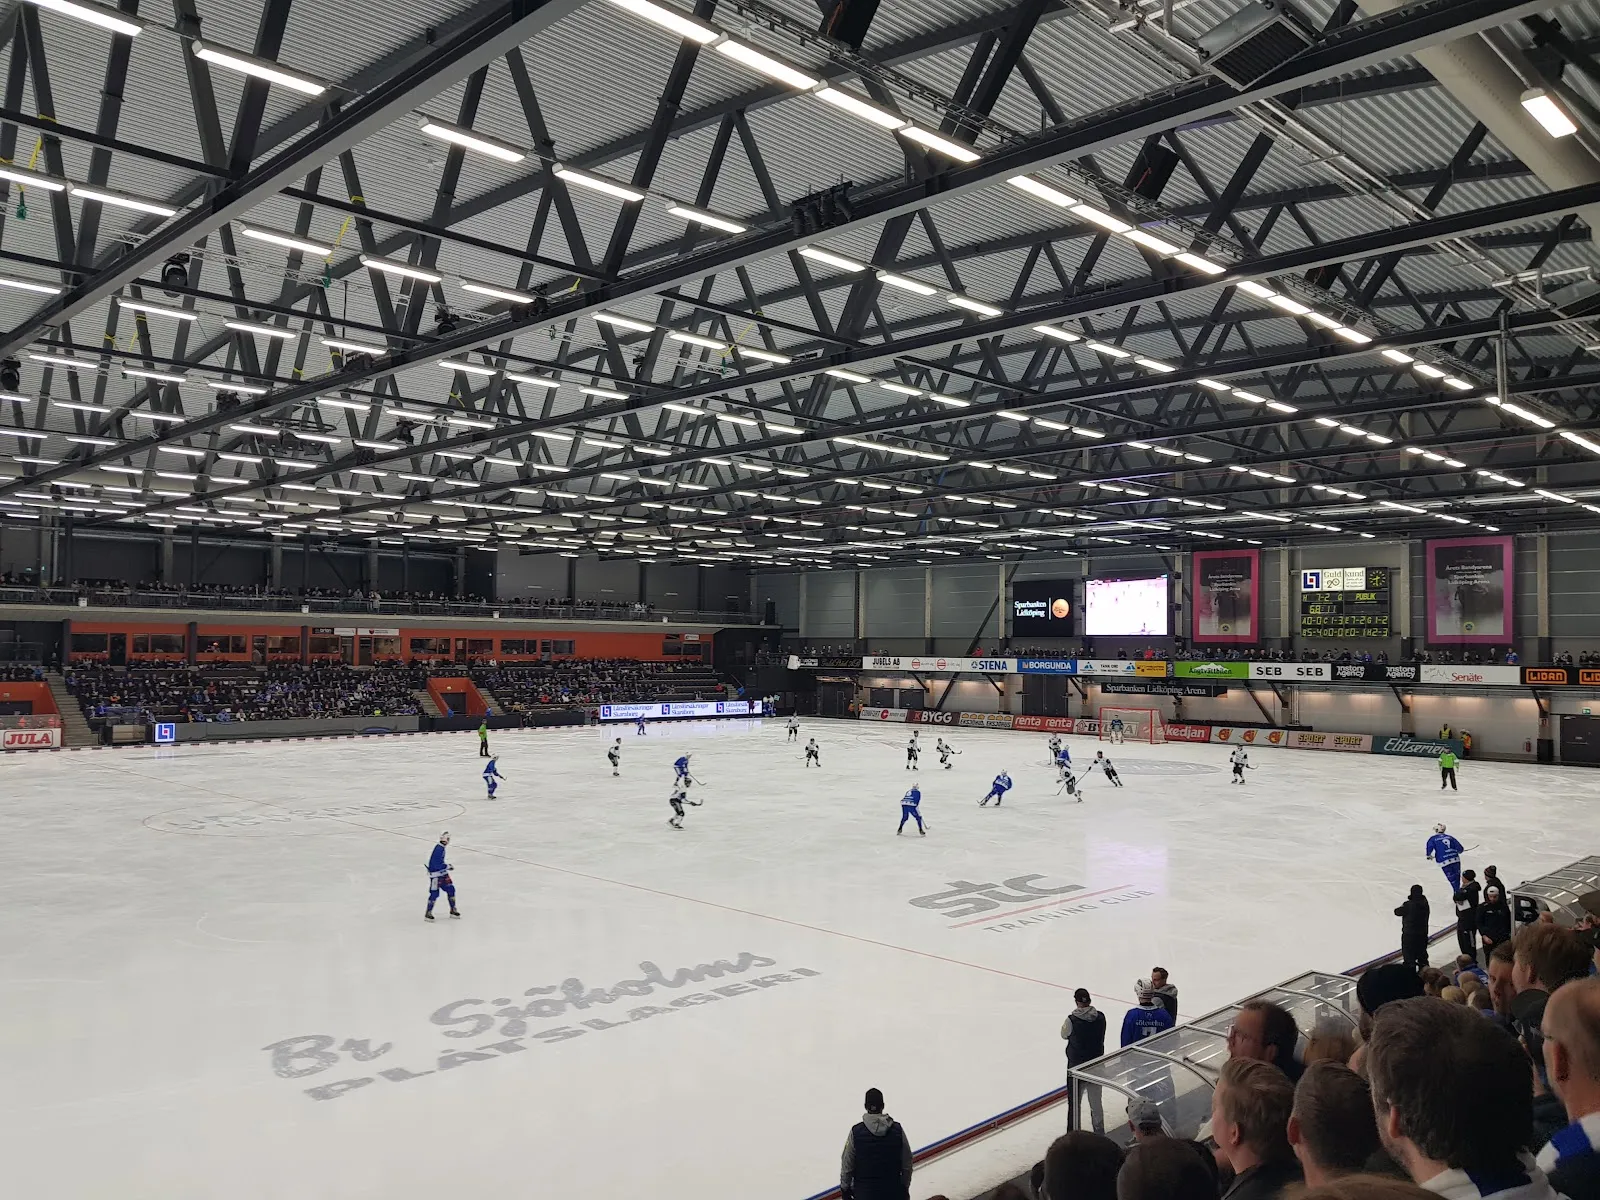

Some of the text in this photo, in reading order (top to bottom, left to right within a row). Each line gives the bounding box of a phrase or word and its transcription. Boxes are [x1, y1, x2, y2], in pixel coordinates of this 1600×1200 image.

[1014, 601, 1047, 609] Sparbanken
[1016, 609, 1045, 617] Lidköping
[979, 660, 1007, 671] STENA
[1029, 661, 1072, 670] BORGUNDA
[1256, 666, 1324, 676] SEB SEB
[1386, 671, 1415, 679] Agency
[1451, 672, 1483, 683] Senäte
[1529, 672, 1563, 681] LIDAN
[1106, 683, 1206, 695] Sparbanken Lidköping Arena
[921, 711, 952, 723] BYGG
[1015, 716, 1072, 728] renta renta
[5, 733, 51, 745] JULA
[1298, 734, 1326, 743] SPORT
[1334, 735, 1362, 745] SPORT
[1442, 839, 1450, 849] 9
[983, 890, 1155, 933] TRAINING CLUB
[262, 951, 777, 1079] Br Sjöholms
[303, 968, 822, 1101] PLÅTSLAGERI
